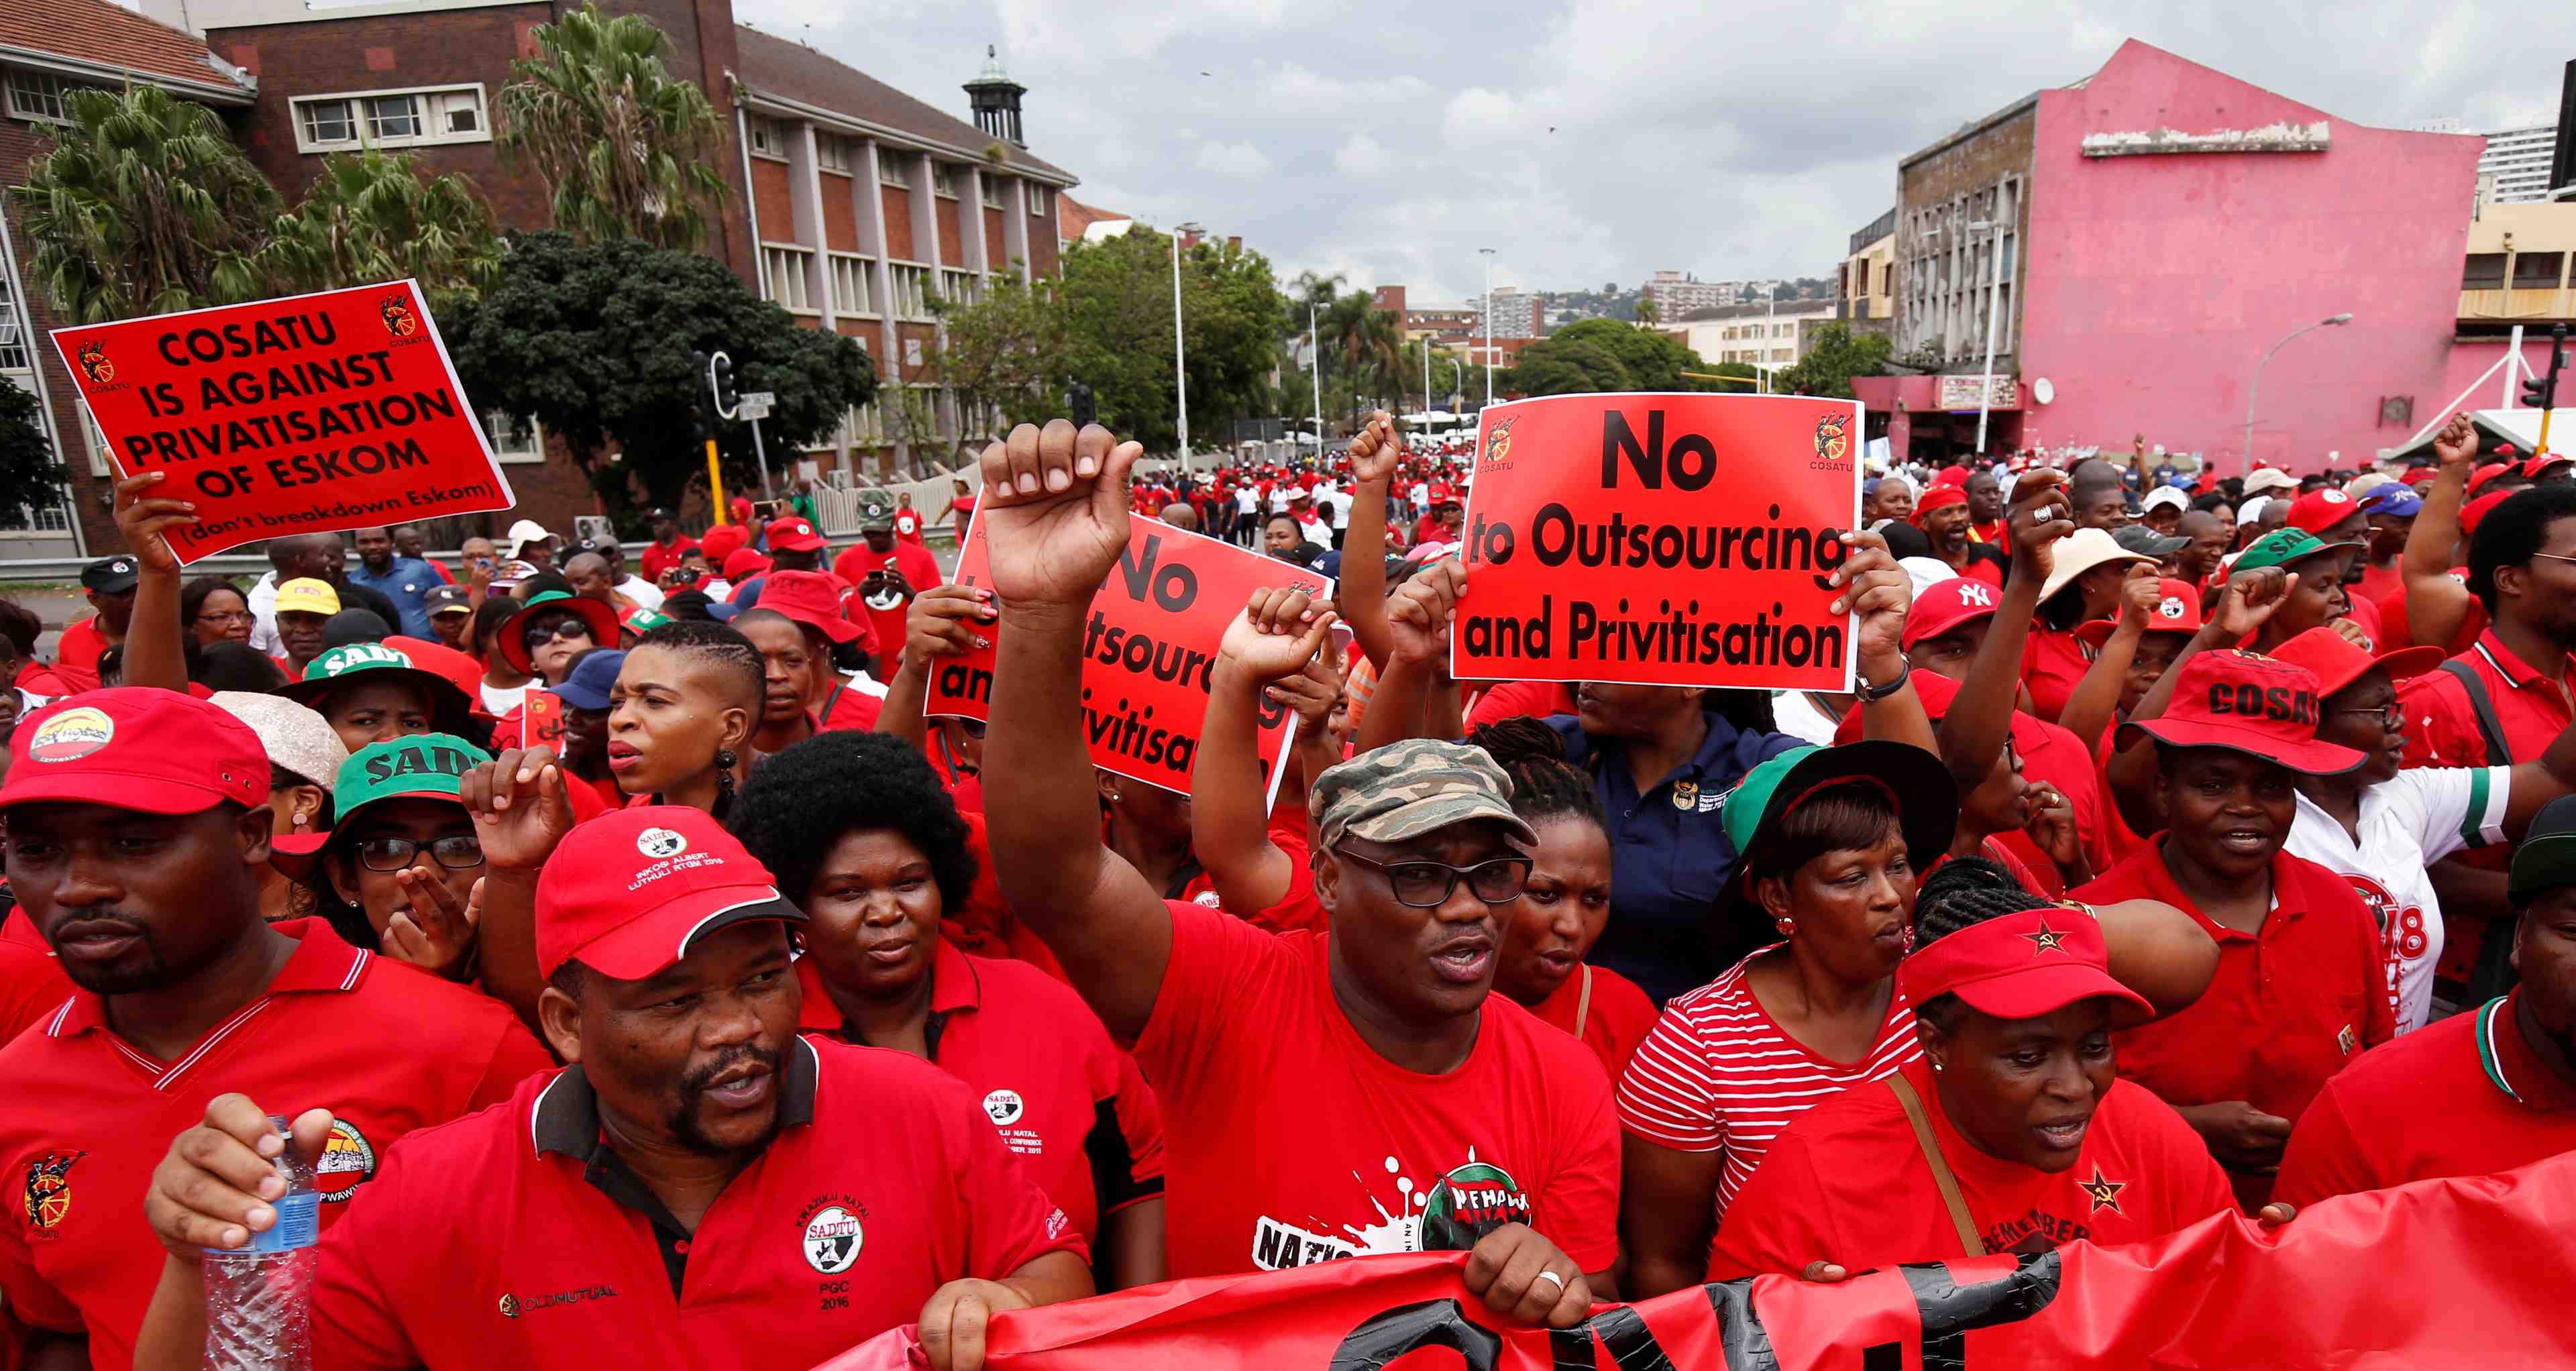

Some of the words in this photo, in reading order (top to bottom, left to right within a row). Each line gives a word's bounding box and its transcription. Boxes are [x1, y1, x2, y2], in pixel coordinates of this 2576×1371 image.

[158, 311, 337, 367] COSATU
[389, 335, 431, 348] COSATU
[89, 382, 131, 395] COSATU
[139, 382, 183, 419] IS
[201, 350, 396, 410] AGAINST
[124, 388, 456, 467] PRIVATISATION
[1601, 409, 1717, 492] No
[195, 464, 255, 499] OF
[265, 437, 430, 490] ESKOM
[1479, 461, 1514, 474] COSATU
[1809, 461, 1854, 472] COSATU
[178, 514, 255, 548] (don't
[262, 496, 402, 527] breakdown
[407, 479, 496, 508] Eskom)
[1468, 512, 1515, 565] to
[1532, 502, 1847, 590] Outsourcing
[1463, 594, 1552, 659] and
[1568, 598, 1842, 669] Privitisation
[939, 663, 994, 706] an
[635, 861, 669, 879] INKOSI
[673, 853, 709, 864] ALBERT
[628, 868, 672, 891] LUTHULI
[987, 1095, 1018, 1103] SADTU
[1014, 1130, 1038, 1138] NATAL
[809, 1221, 857, 1239] SADTU
[819, 1280, 849, 1295] PGC
[821, 1296, 849, 1310] 2016
